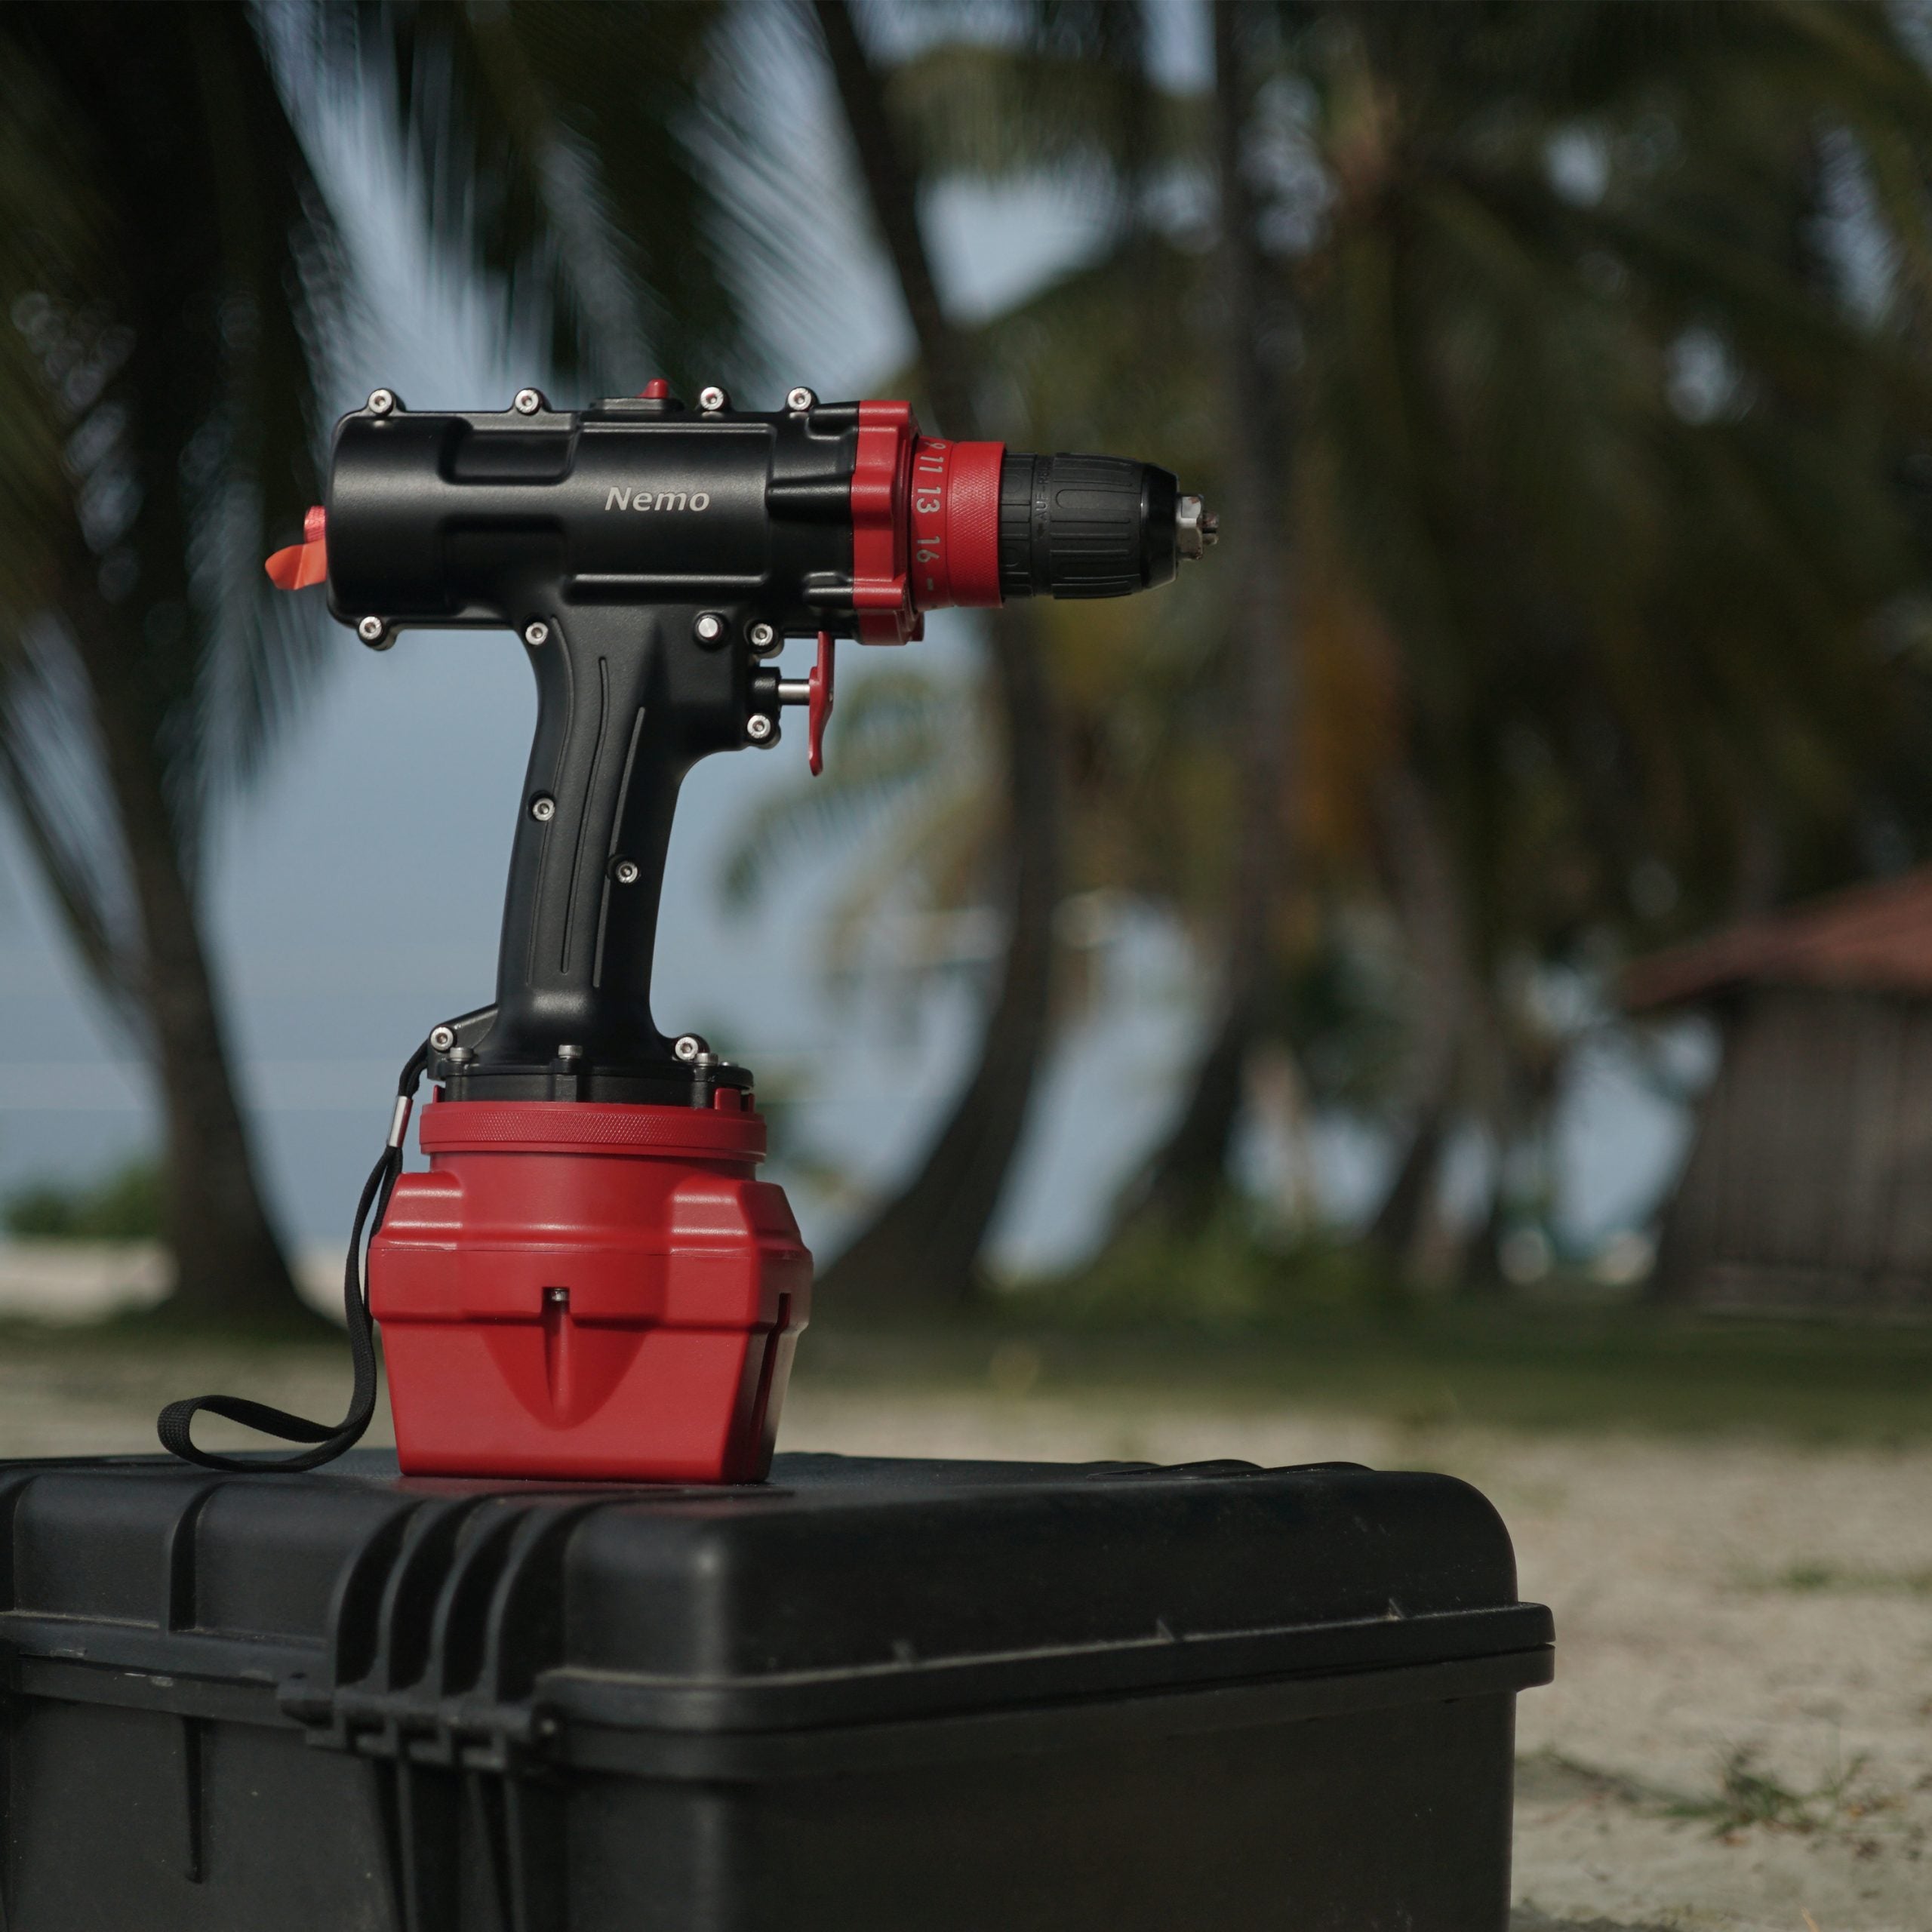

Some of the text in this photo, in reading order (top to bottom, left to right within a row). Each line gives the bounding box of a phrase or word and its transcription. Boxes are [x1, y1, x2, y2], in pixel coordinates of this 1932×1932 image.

[918, 456, 944, 473] 11
[605, 486, 710, 512] Nemo
[916, 485, 942, 513] 13
[916, 535, 940, 563] 16
